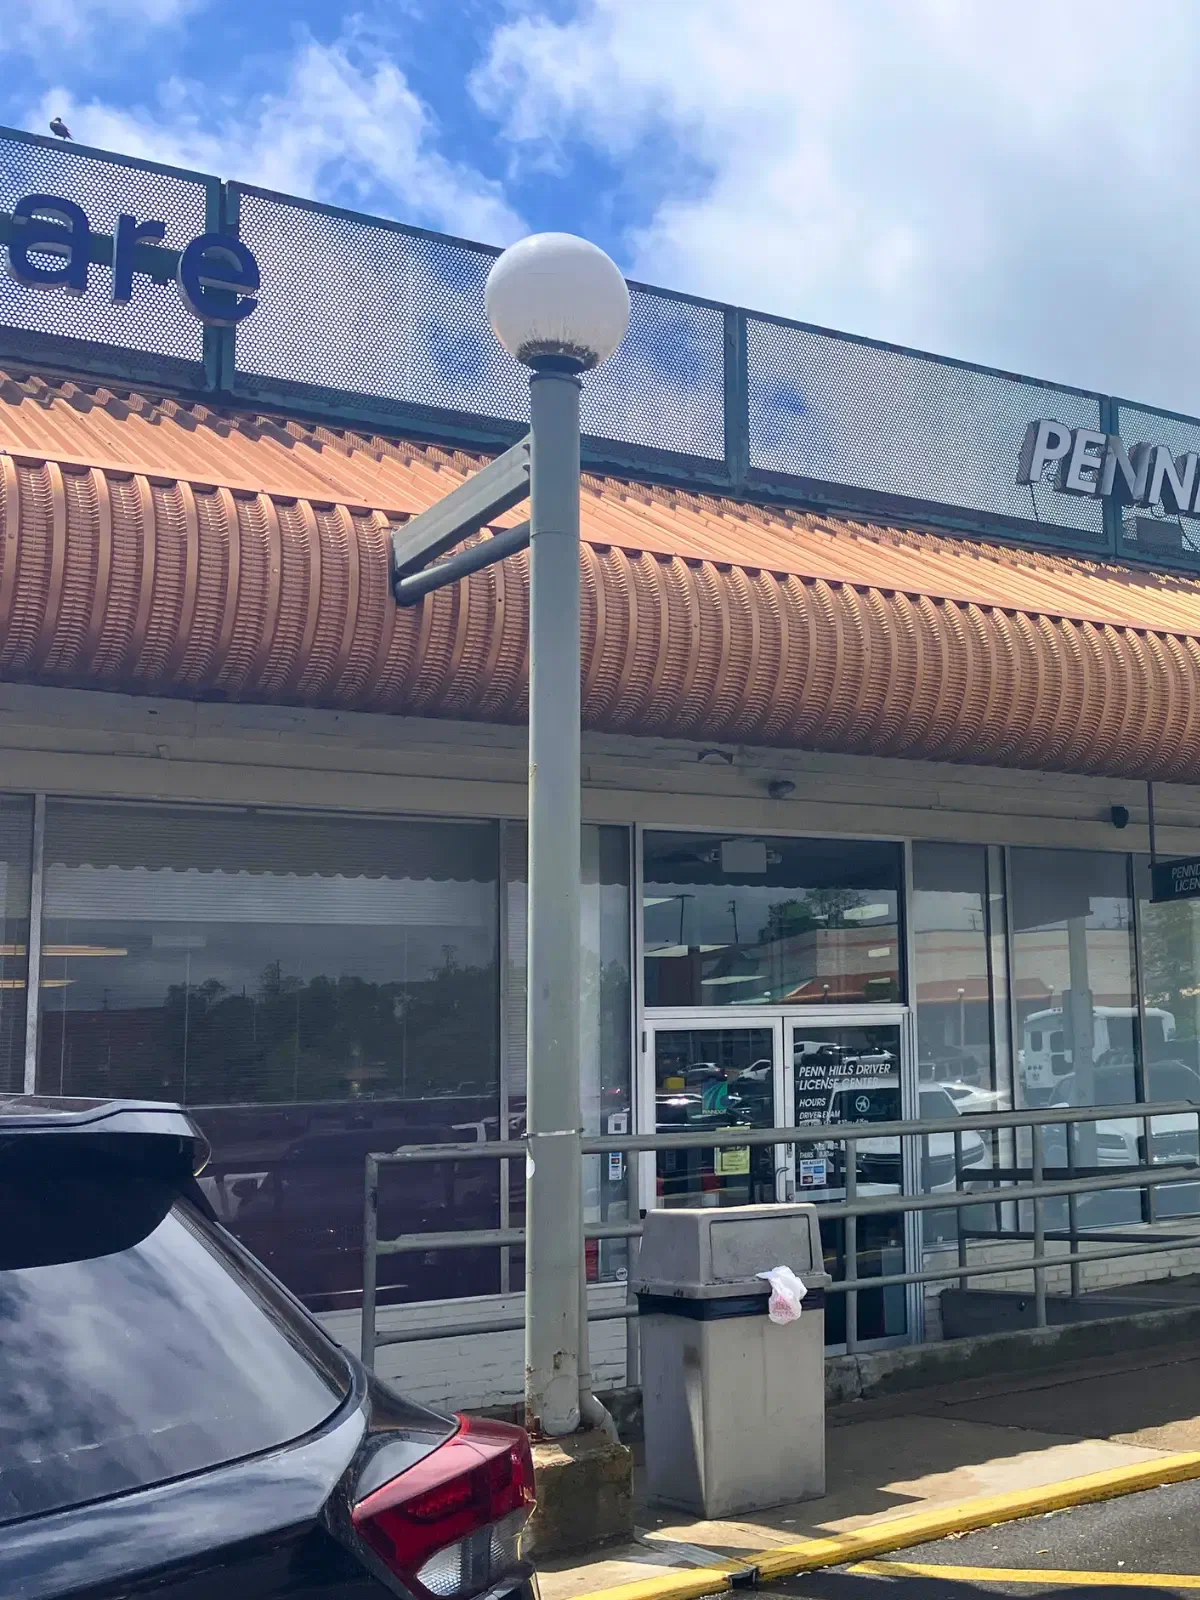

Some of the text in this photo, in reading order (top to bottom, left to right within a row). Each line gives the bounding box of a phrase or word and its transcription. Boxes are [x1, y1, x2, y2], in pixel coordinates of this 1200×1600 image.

[6, 193, 260, 326] are
[799, 1063, 891, 1078] PENN HILLS DRIVER
[799, 1076, 880, 1091] LICENSE CENTER
[799, 1097, 827, 1108] HOURS
[799, 1110, 841, 1120] DRIVER EXAM
